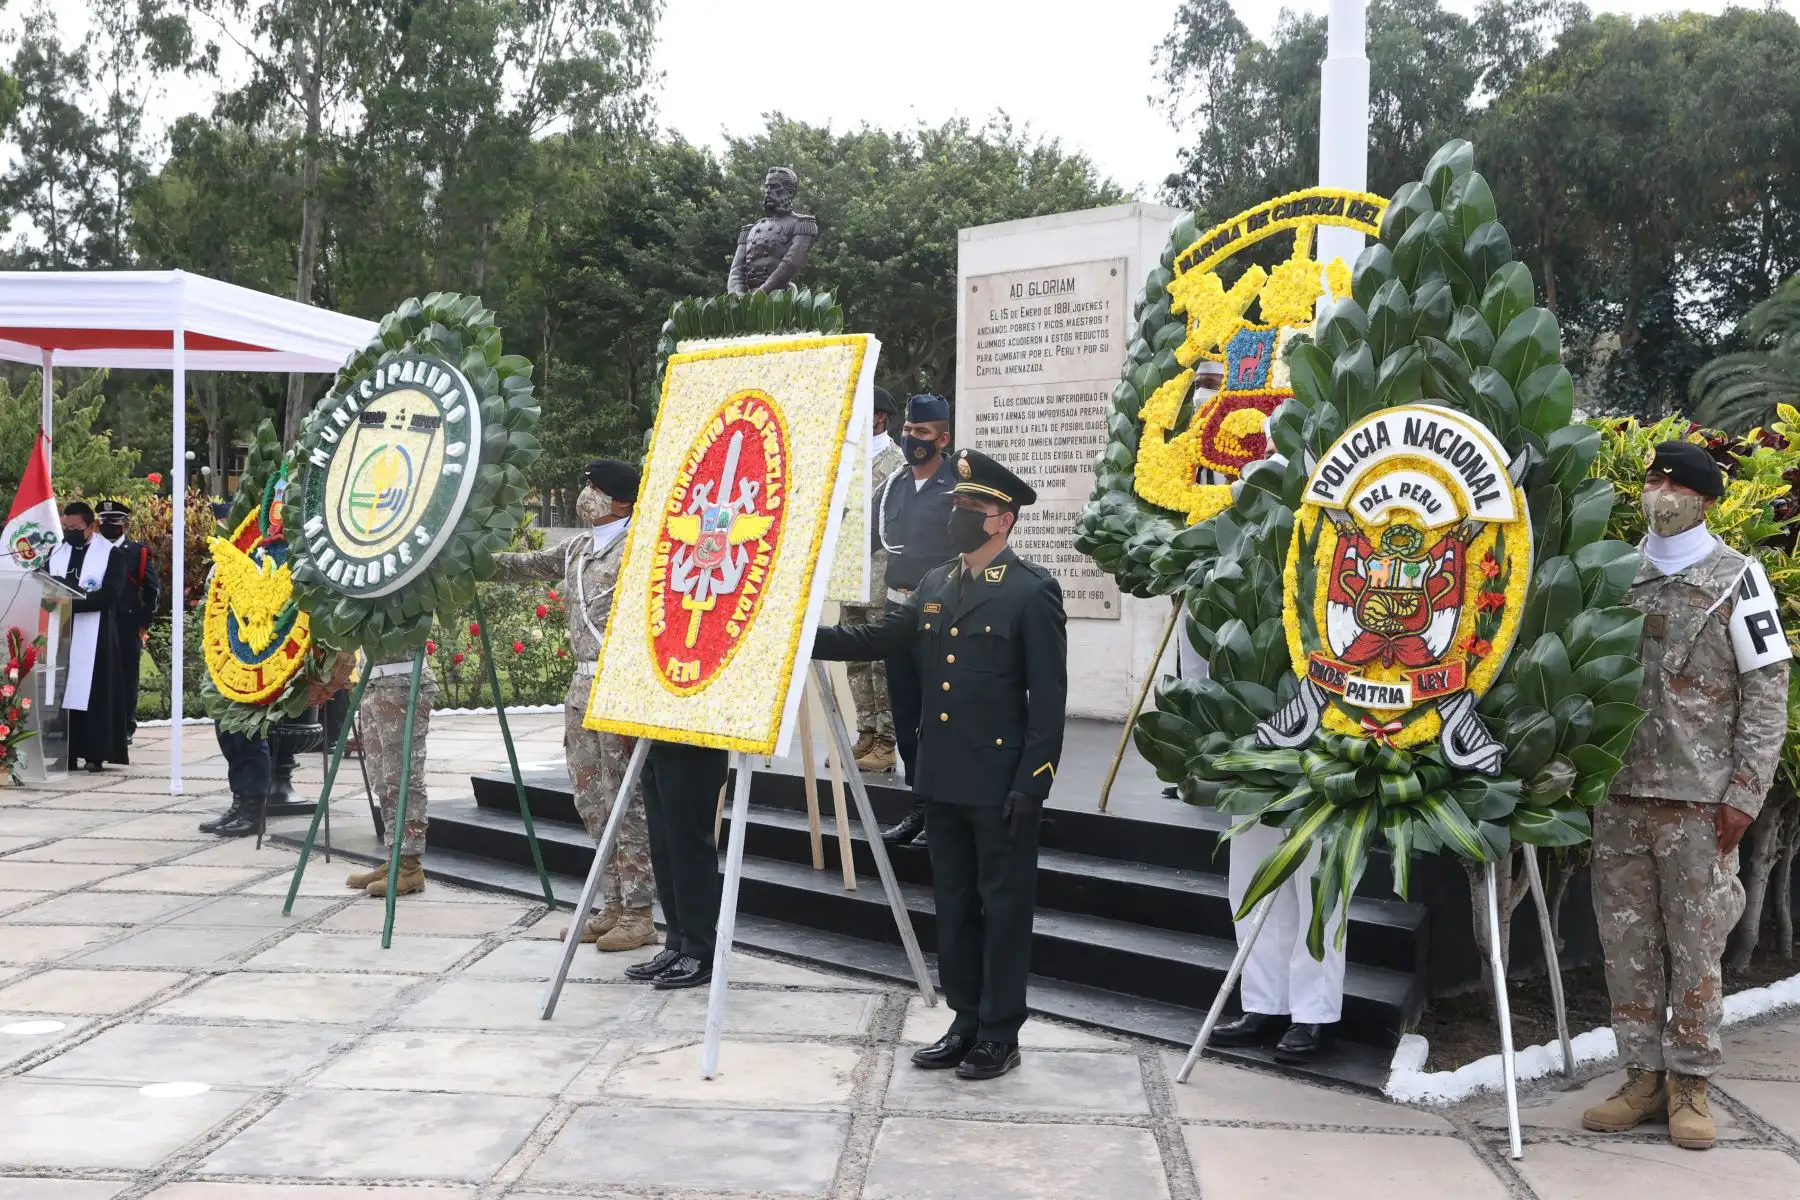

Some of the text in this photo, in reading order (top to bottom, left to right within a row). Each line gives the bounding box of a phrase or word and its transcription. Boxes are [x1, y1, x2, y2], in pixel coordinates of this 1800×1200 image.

[1247, 209, 1270, 234] DE
[1271, 197, 1345, 222] GUERRA
[1344, 201, 1381, 227] DEL
[1010, 277, 1075, 298] AD GLORIAM
[1000, 308, 1008, 319] 15
[1072, 301, 1103, 313] JOVENES
[1105, 300, 1110, 309] Y
[1010, 322, 1036, 333] POBRES
[1038, 322, 1042, 331] Y
[1066, 315, 1103, 327] MAESTROS
[976, 329, 1109, 350] ALUMNOS ACUDIERON A ESTOS REDUCTOS
[976, 353, 993, 363] PARA
[995, 350, 1027, 362] COMBATIR
[1028, 349, 1042, 359] POR
[1044, 348, 1053, 358] EL
[1077, 346, 1081, 354] Y
[1083, 344, 1098, 354] POR
[1099, 343, 1109, 353] SU
[1015, 395, 1045, 406] CONOCIAN
[1046, 395, 1055, 404] SU
[1056, 392, 1098, 404] INFERIORIDAD
[1100, 392, 1108, 401] EN
[310, 360, 466, 468] MUNICIPALIDAD
[742, 400, 769, 431] LAS
[976, 412, 999, 422] NUMERO
[1000, 412, 1004, 421] Y
[1028, 410, 1036, 419] SU
[1037, 407, 1078, 419] IMPROVISADA
[990, 425, 1014, 435] MILITAR
[1020, 424, 1029, 434] LA
[1031, 423, 1048, 433] FALTA
[1050, 423, 1059, 432] DE
[1061, 420, 1108, 432] POSIBILIDADES
[975, 440, 983, 449] DE
[1010, 438, 1026, 448] PERO
[1028, 437, 1053, 447] TAMBIEN
[1054, 435, 1097, 446] COMPRENDIAN
[667, 416, 725, 513] CONJUNTO
[1009, 452, 1020, 463] QUE
[1022, 452, 1030, 461] DE
[1031, 451, 1052, 461] ELLOS
[1053, 450, 1074, 460] EXIGIA
[1075, 450, 1084, 459] EL
[1312, 417, 1500, 511] POLICIA NACIONAL
[1039, 465, 1043, 474] Y
[1045, 464, 1078, 474] LUCHARON
[1359, 481, 1442, 514] DEL PERU
[1032, 512, 1040, 521] DE
[1013, 526, 1022, 535] SU
[303, 515, 430, 588] MIRAFLORES
[1010, 540, 1073, 549] LAS GENERACIONES
[1043, 554, 1053, 563] DEL
[1056, 554, 1083, 563] SAGRADO
[1063, 568, 1068, 577] Y
[1070, 568, 1079, 577] EL
[651, 541, 672, 637] COMANDO
[725, 538, 772, 638] ARMADAS
[1077, 590, 1086, 599] DE
[1088, 590, 1104, 600] 1960
[1744, 609, 1789, 655] P
[1309, 659, 1449, 704] DIOS PATRIA LEY
